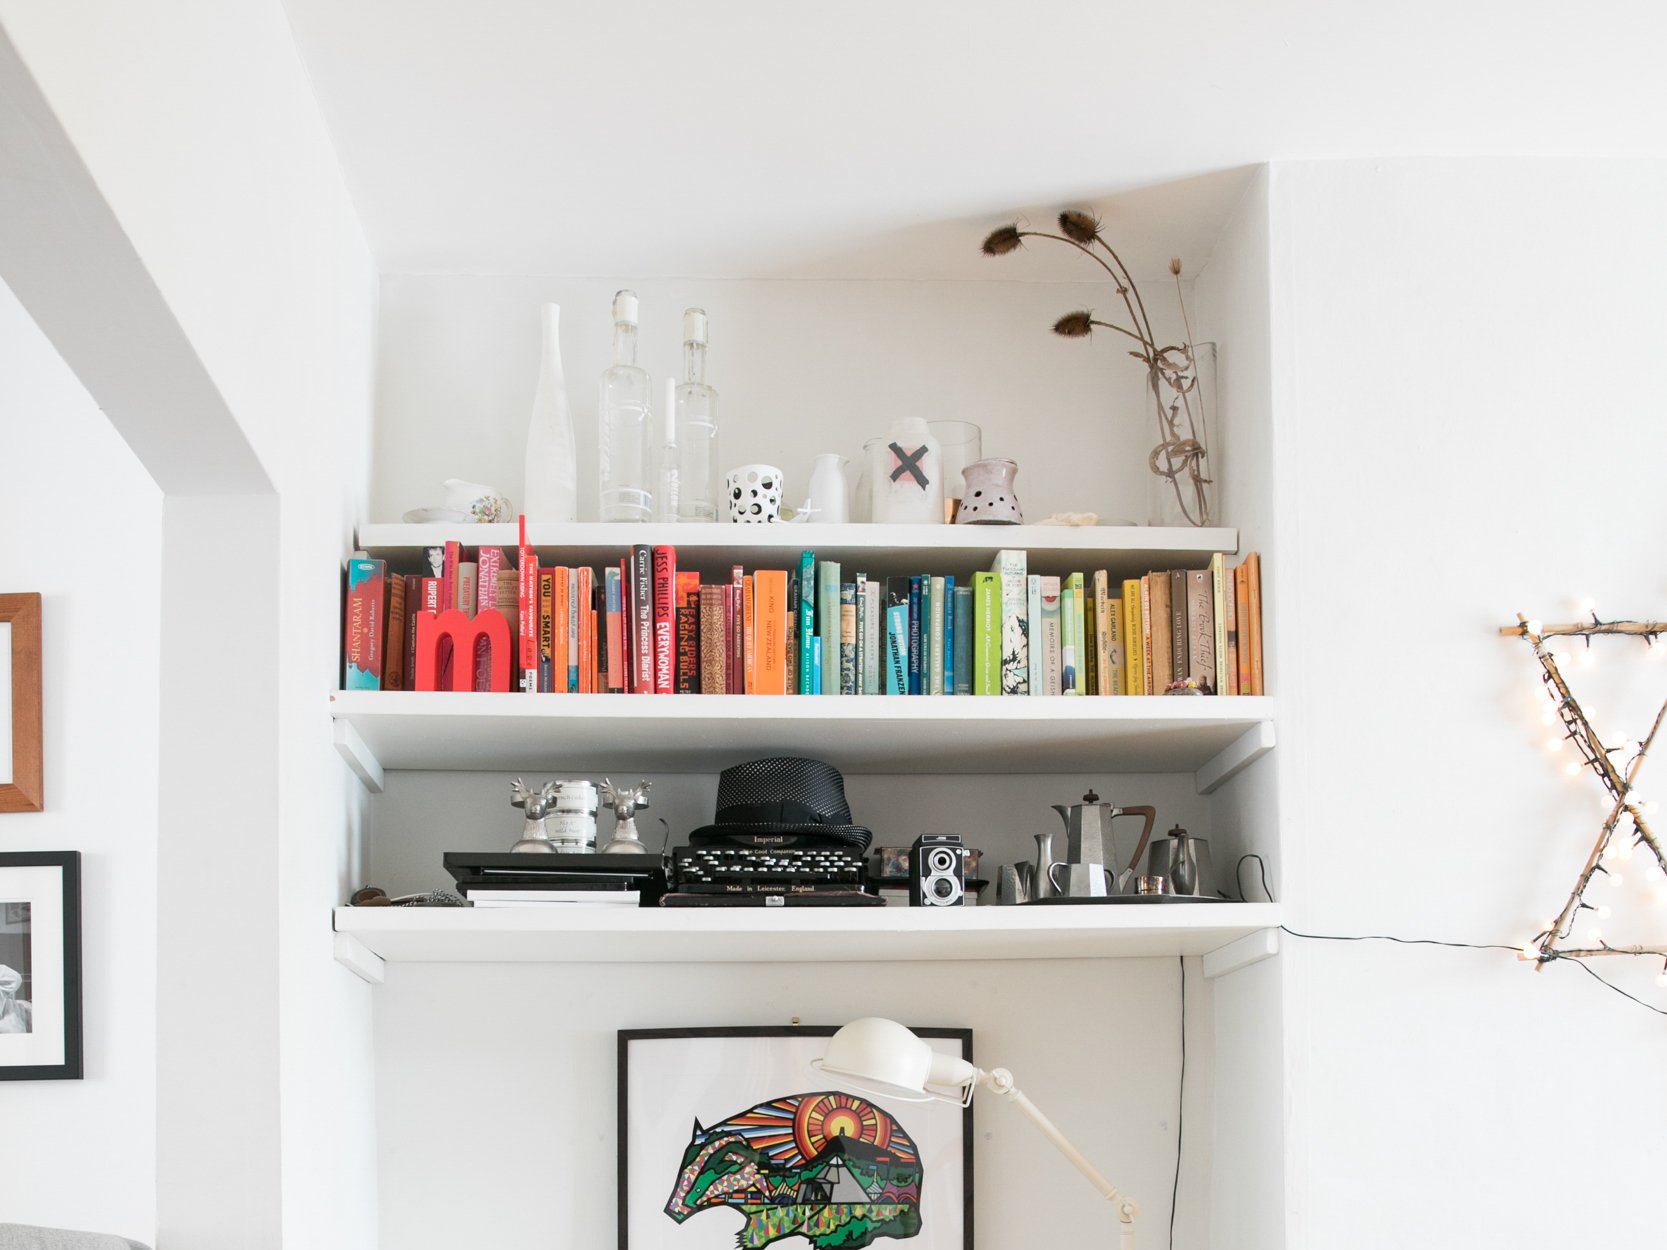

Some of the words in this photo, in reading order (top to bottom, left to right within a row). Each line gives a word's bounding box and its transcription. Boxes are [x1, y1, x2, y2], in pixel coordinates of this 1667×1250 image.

[639, 550, 647, 574] Carrie
[656, 549, 669, 573] JESS
[480, 549, 489, 606] JONATHAN
[639, 577, 648, 601] Fisher
[427, 581, 436, 608] RUPERT
[657, 577, 669, 618] PHILLIPS
[1198, 591, 1209, 609] The
[640, 605, 649, 619] The
[687, 608, 695, 637] EASY
[805, 608, 813, 626] Fun
[1198, 611, 1212, 641] Book
[351, 597, 362, 662] SHANTARAM
[368, 621, 376, 638] David
[542, 614, 550, 648] SMART
[640, 621, 650, 654] Princess
[679, 608, 688, 652] RAGING
[805, 628, 813, 649] Home
[368, 639, 376, 661] Gregory
[656, 622, 670, 689] EVERYWOMAN
[687, 641, 696, 676] RIDERS
[889, 632, 901, 665] JONATHAN
[911, 620, 919, 674] PHOTOGRAPHY
[1049, 656, 1055, 665] OF
[1196, 640, 1212, 670] Thief
[641, 656, 650, 682] Diarist
[679, 656, 688, 689] BULLS
[894, 666, 906, 695] FRANZEN
[754, 836, 783, 844] Imperial
